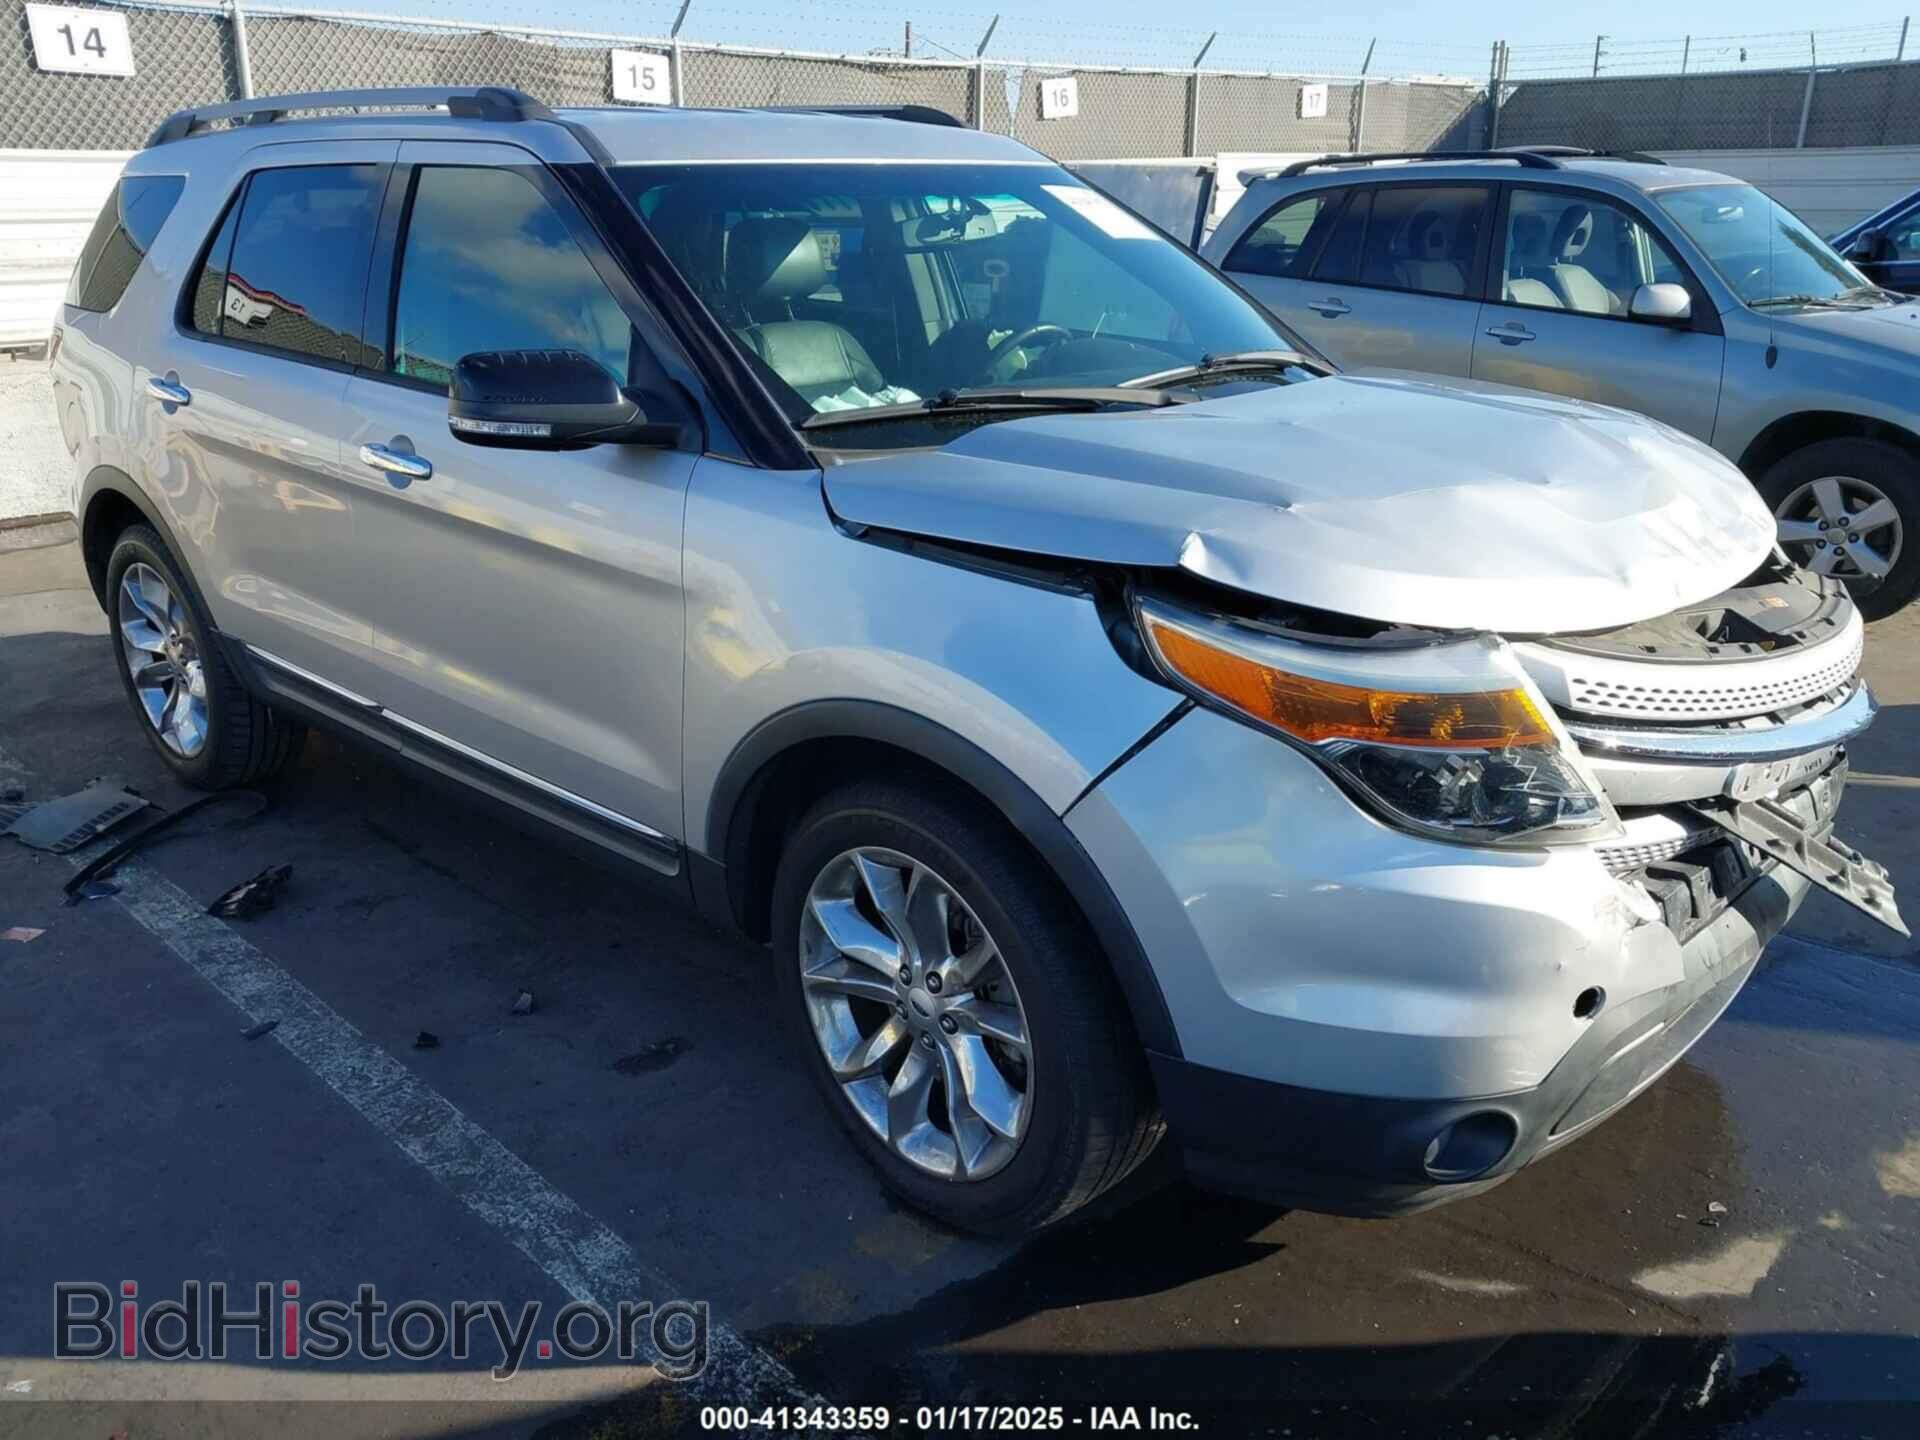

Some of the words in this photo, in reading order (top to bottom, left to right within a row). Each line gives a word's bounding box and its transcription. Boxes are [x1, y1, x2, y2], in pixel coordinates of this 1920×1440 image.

[57, 24, 106, 57] 14
[627, 64, 655, 90] 15
[1051, 88, 1069, 107] 16
[1309, 93, 1320, 109] 17
